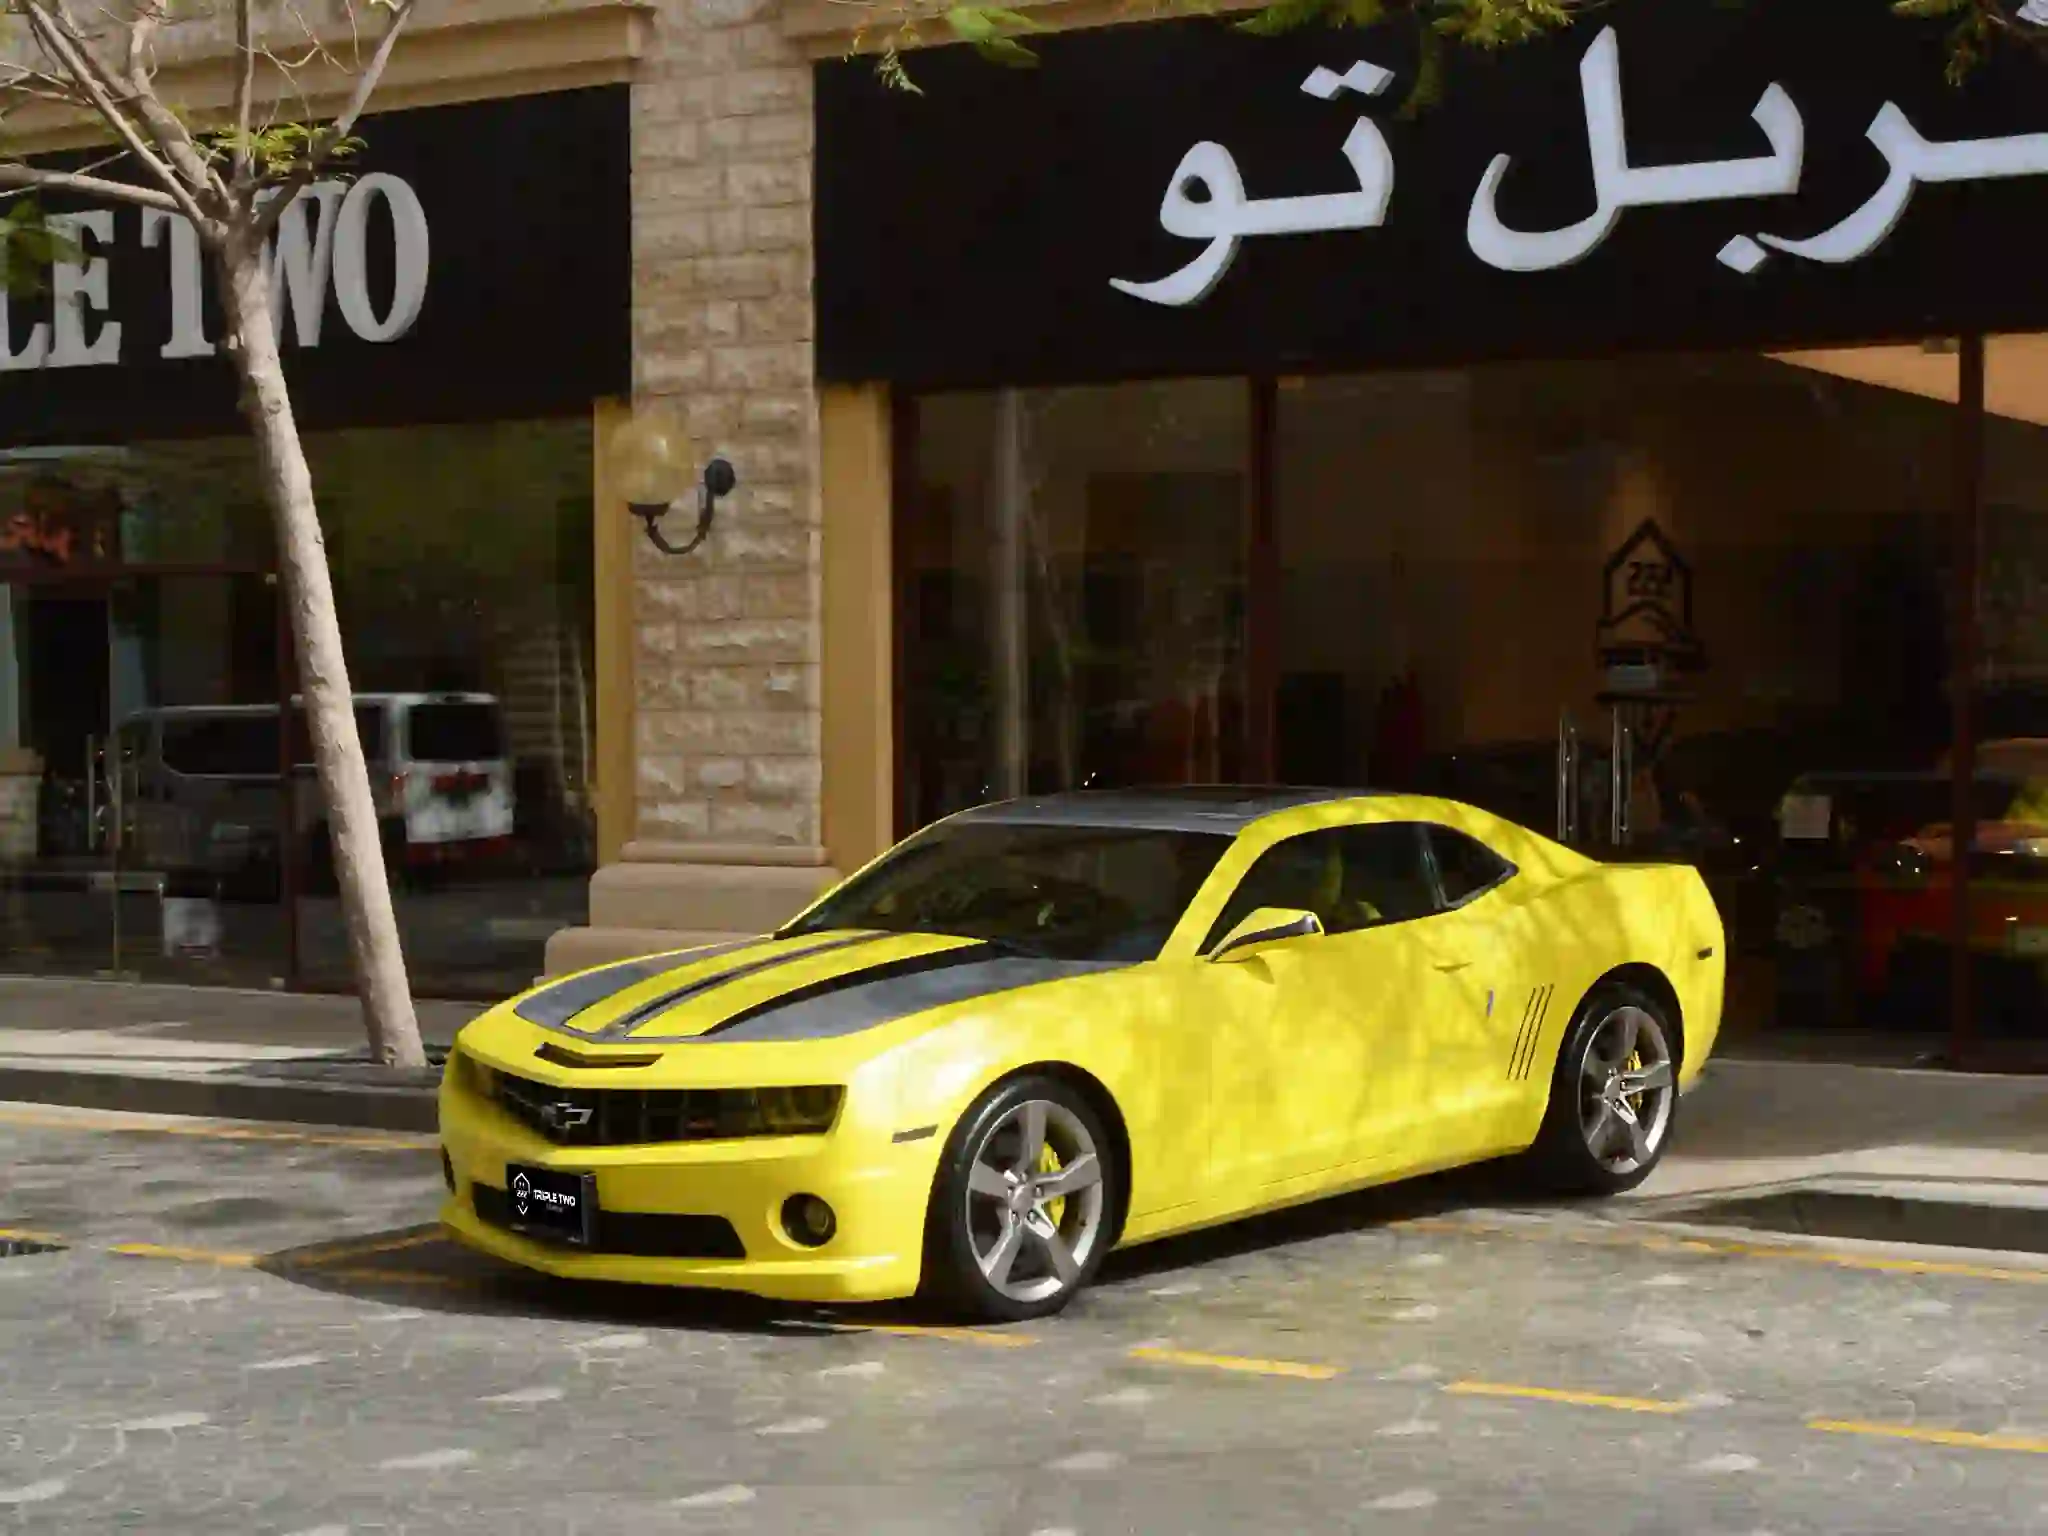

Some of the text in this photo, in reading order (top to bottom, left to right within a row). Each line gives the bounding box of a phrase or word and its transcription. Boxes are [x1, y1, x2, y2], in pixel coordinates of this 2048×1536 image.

[1108, 10, 2048, 307] ربل تو
[558, 1193, 576, 1207] TWO
